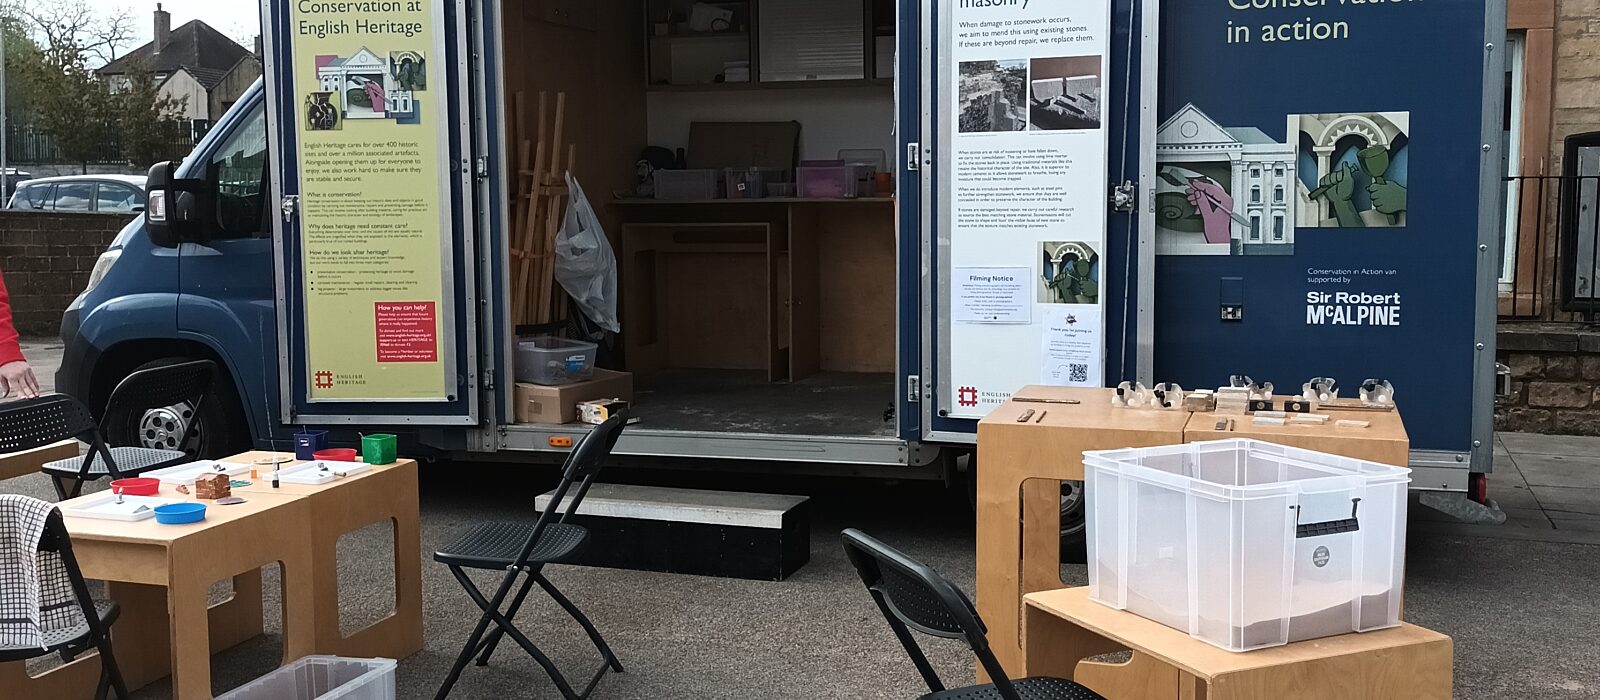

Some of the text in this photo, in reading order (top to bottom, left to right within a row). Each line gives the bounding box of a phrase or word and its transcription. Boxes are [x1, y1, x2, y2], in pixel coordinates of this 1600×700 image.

[298, 0, 421, 13] Conservation at
[300, 20, 422, 38] English Heritage
[1226, 17, 1349, 43] in action
[1307, 292, 1400, 304] Sir Robert
